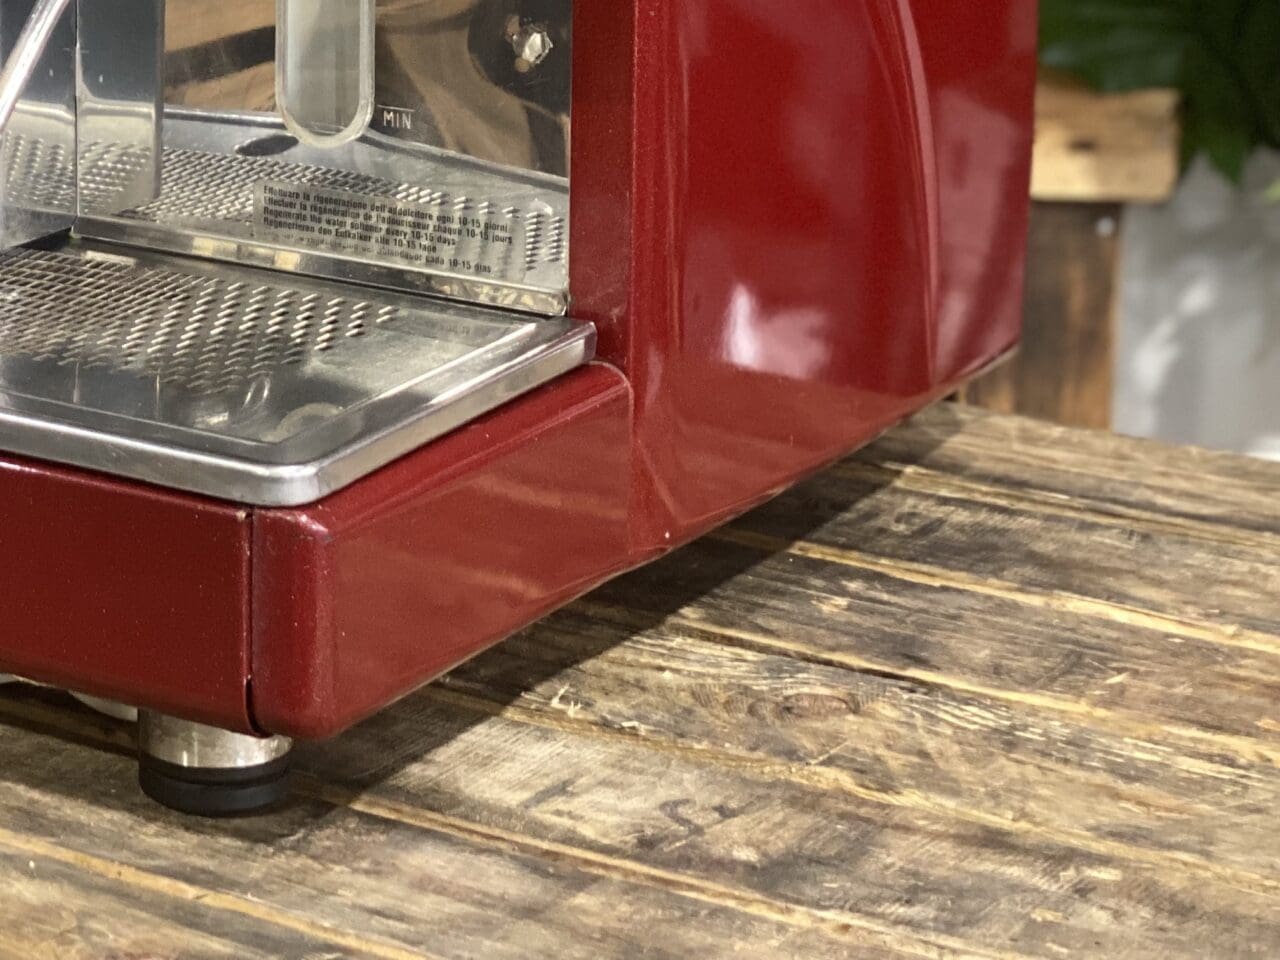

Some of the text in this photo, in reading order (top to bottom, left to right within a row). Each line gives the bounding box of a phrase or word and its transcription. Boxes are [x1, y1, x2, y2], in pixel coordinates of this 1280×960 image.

[383, 110, 411, 129] MIN
[458, 217, 480, 228] 10-15
[411, 230, 433, 241] 10-15
[437, 234, 455, 246] days
[466, 228, 488, 240] 10-15
[492, 232, 512, 244] jours
[449, 258, 471, 270] 10-15
